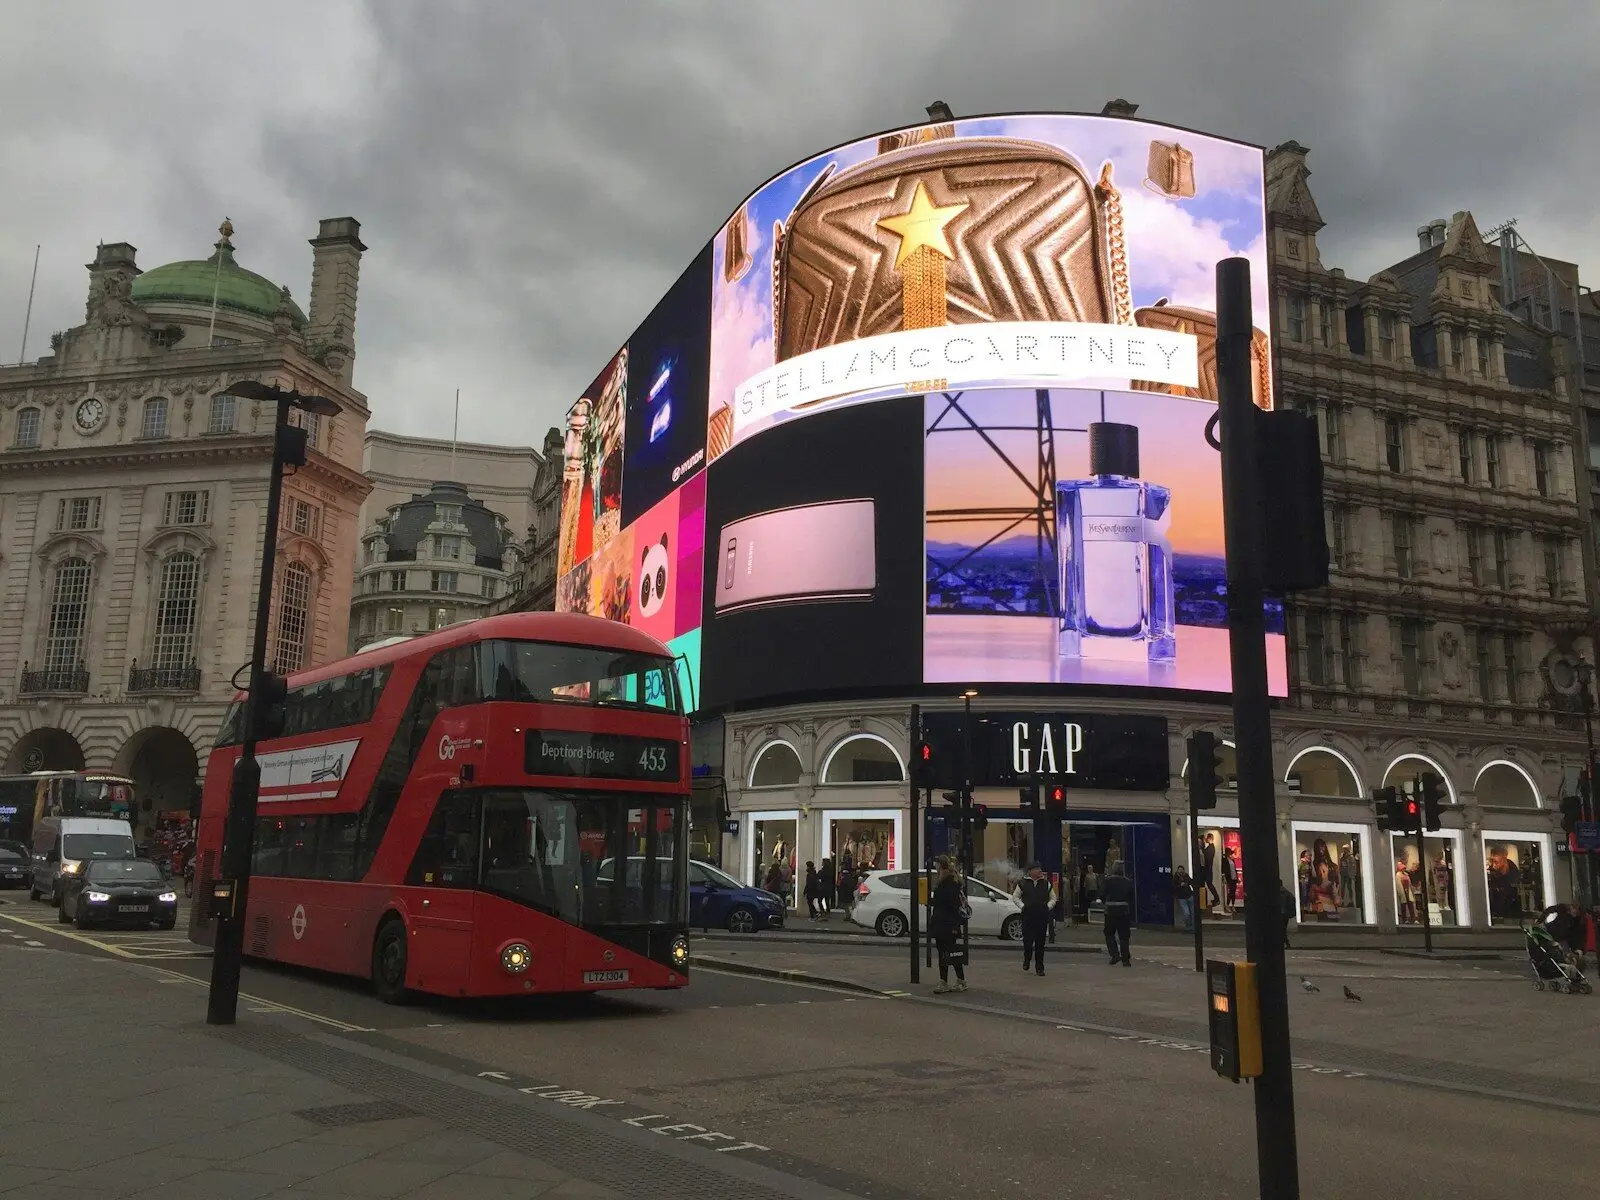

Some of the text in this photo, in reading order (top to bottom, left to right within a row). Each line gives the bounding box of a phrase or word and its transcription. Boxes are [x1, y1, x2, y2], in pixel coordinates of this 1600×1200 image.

[541, 741, 615, 765] Deptford Bridge
[638, 747, 667, 773] 453
[1012, 721, 1082, 774] GAP
[119, 811, 130, 819] 88
[518, 1084, 625, 1109] LOOK
[622, 1113, 771, 1152] LEFT
